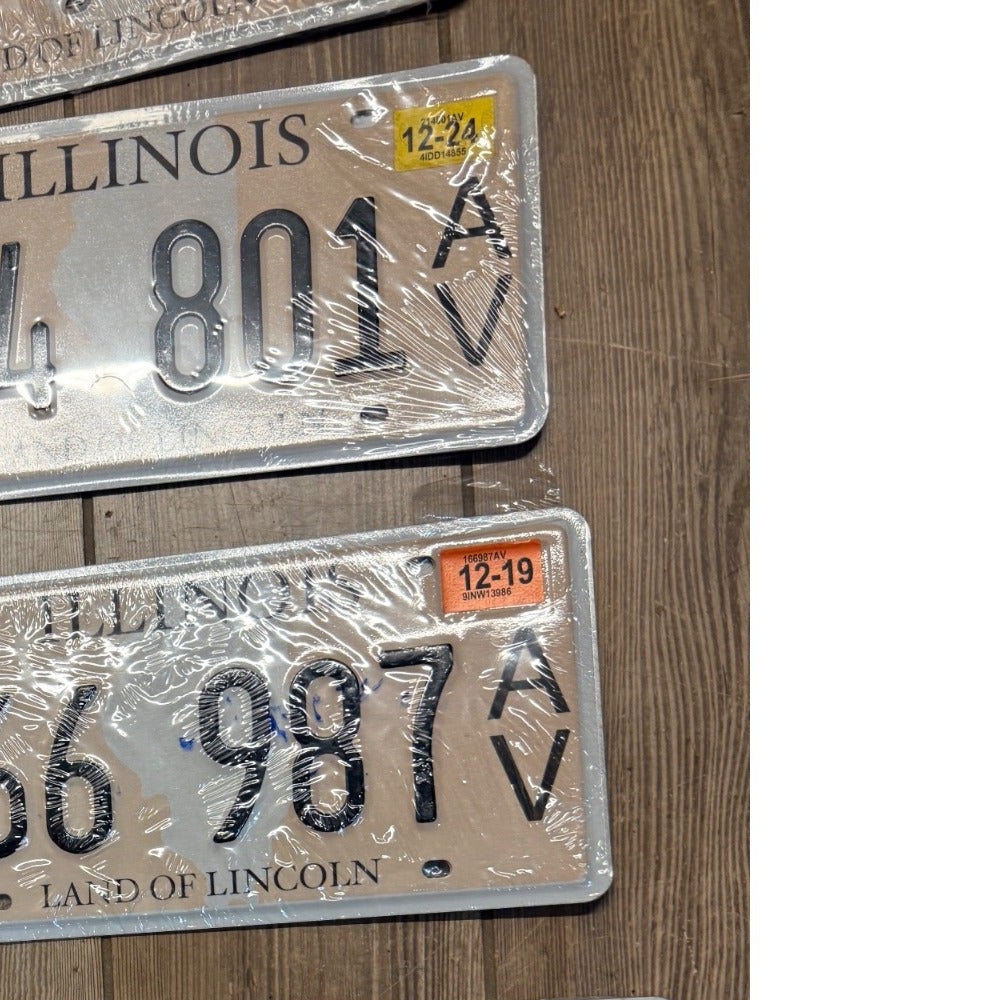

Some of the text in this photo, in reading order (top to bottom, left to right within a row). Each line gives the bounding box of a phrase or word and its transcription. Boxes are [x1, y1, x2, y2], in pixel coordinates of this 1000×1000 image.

[37, 31, 83, 65] OF
[402, 117, 478, 153] 12-24
[151, 196, 407, 393] 801
[458, 556, 535, 591] 12-19
[201, 643, 455, 844] 987
[40, 858, 382, 909] LAND OF LINCOLN
